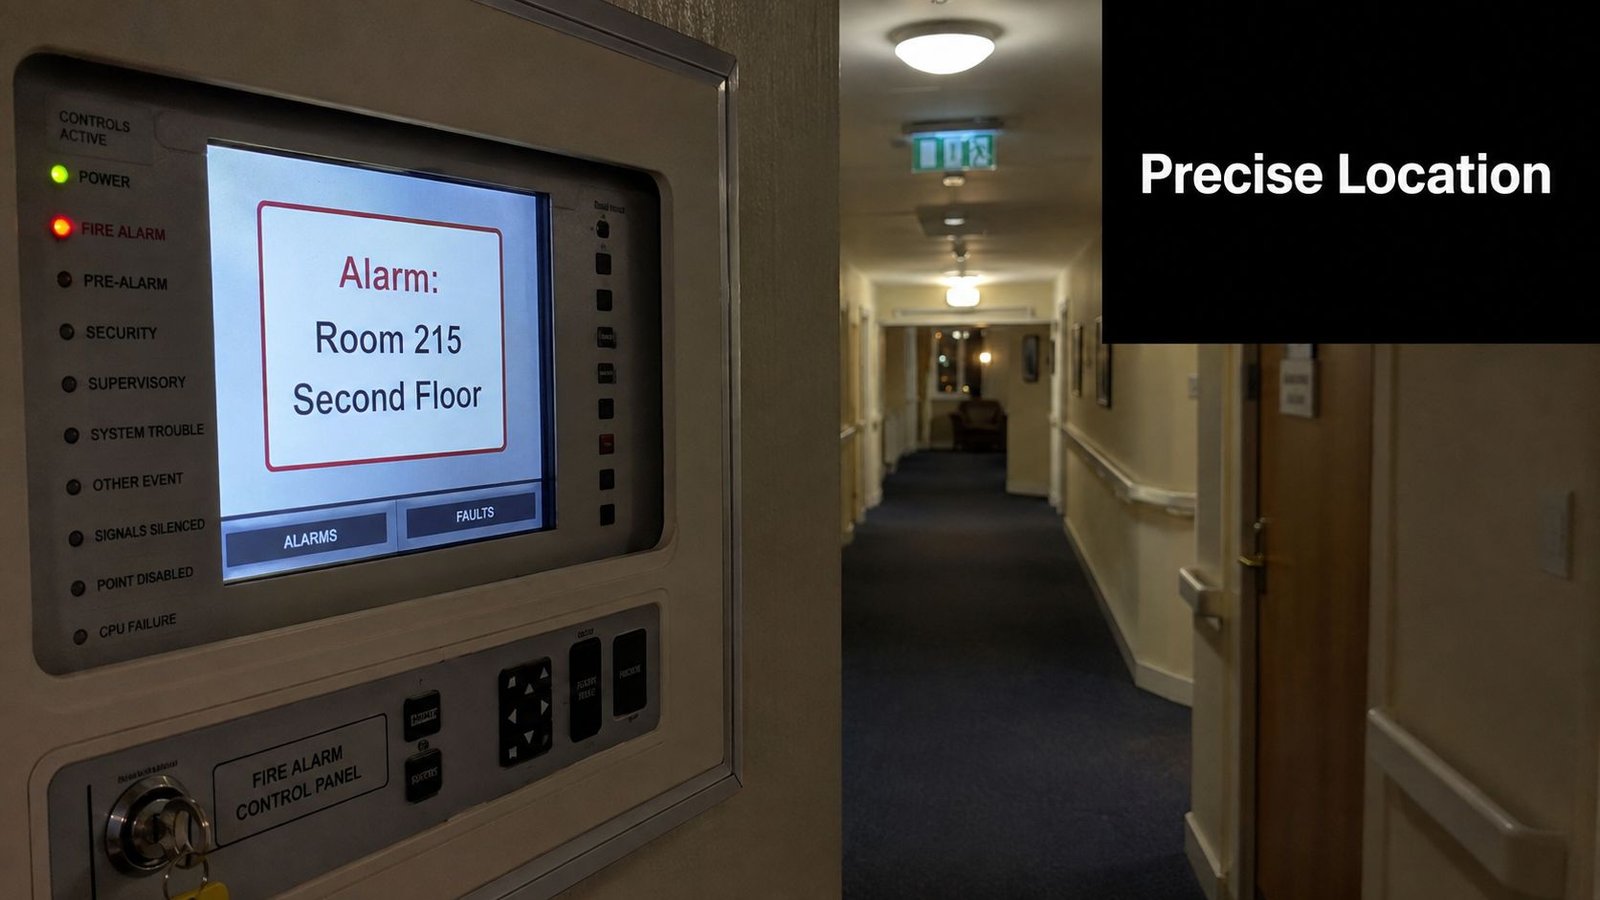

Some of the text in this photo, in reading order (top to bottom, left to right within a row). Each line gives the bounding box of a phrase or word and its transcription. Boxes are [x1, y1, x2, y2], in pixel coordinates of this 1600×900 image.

[59, 110, 131, 133] CONTROLS
[60, 128, 107, 146] ACTIVE
[79, 170, 130, 188] POWER
[81, 222, 166, 241] FIRE ALARM
[84, 274, 168, 290] PRE-ALARM
[339, 255, 439, 294] Alarm:
[86, 326, 157, 340] SECURITY
[316, 321, 462, 354] Room 215
[88, 375, 186, 391] SUPERVISORY
[293, 381, 482, 416] Second Floor
[91, 423, 205, 441] SYSTEM TROUBLE
[93, 472, 184, 492] OTHER EVENT
[456, 506, 495, 523] FAULTS
[95, 518, 205, 542] SIGNALS SILENCED
[283, 529, 338, 550] ALARMS
[97, 566, 194, 592] POINT DISABLED
[99, 613, 177, 639] CPU FAILURE
[252, 745, 343, 789] FIRE ALARM
[236, 765, 362, 821] CONTROL PANEL
